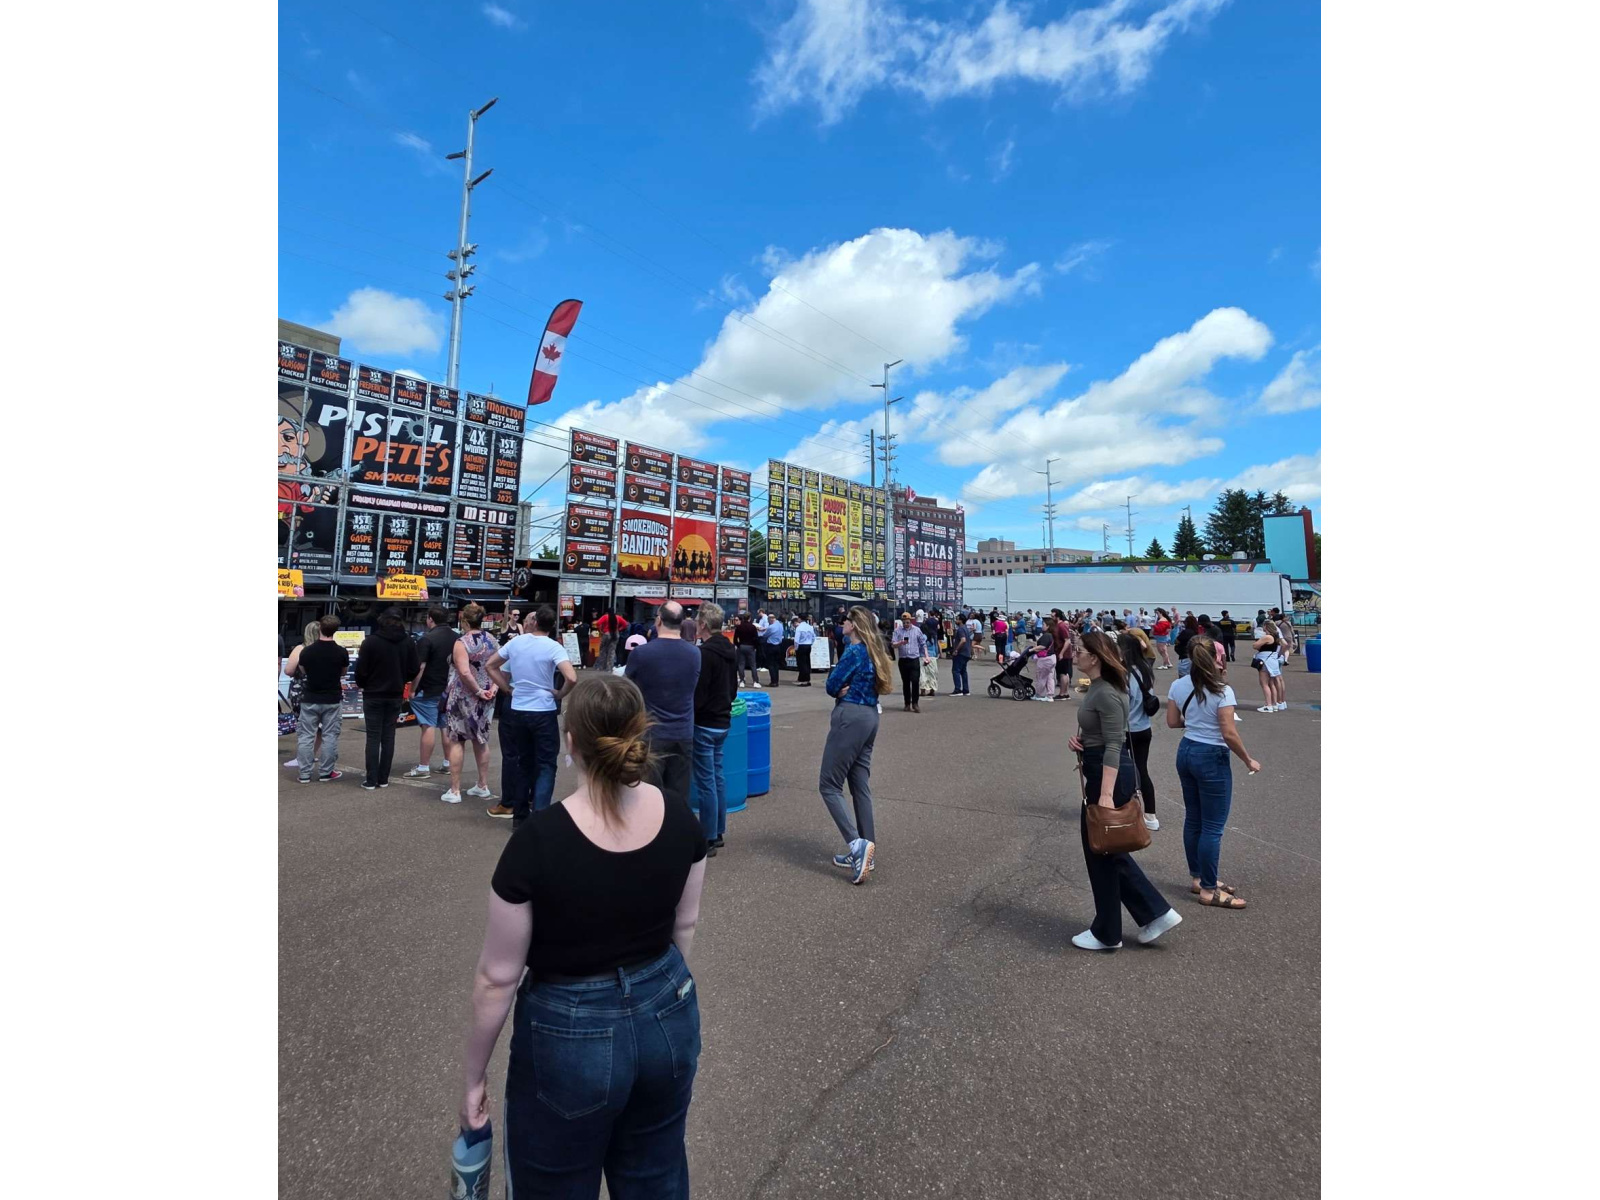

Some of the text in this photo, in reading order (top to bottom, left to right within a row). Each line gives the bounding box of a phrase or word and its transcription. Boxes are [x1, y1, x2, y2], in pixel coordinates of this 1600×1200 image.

[282, 345, 295, 354] 1ST
[281, 360, 306, 371] GLASGOW
[281, 368, 304, 378] CHICKEN
[321, 369, 340, 380] GASPE
[326, 380, 347, 389] CHICKEN
[359, 381, 390, 394] FREDERICTON
[398, 389, 422, 400] HALIFAX
[436, 398, 452, 408] GASPE
[473, 400, 485, 408] 1ST
[487, 400, 523, 419] MONCTON
[318, 404, 448, 444] PISTOL
[491, 413, 518, 425] BEST RIBS
[503, 423, 520, 431] SAUCE
[469, 430, 485, 446] 4X
[501, 439, 515, 448] 1ST
[353, 437, 451, 472] PETE'S
[465, 444, 488, 455] WINNER
[496, 459, 518, 469] SYDNEY
[496, 467, 516, 476] RIBFEST
[364, 471, 451, 485] SMOKEHOUSE
[352, 495, 376, 505] PROUDLY
[376, 498, 400, 508] CANADIAN
[423, 504, 445, 512] OPERATED
[497, 494, 512, 503] 2025
[354, 515, 371, 524] 1ST
[464, 506, 508, 524] MENU
[392, 519, 407, 527] 1ST
[623, 519, 668, 536] SMOKEHOUSE
[350, 534, 372, 543] GASPE
[424, 541, 442, 549] GASPE
[621, 533, 668, 557] BANDITS
[916, 540, 953, 560] TEXAS
[769, 576, 785, 588] BEST
[786, 578, 800, 588] RIBS
[851, 580, 862, 590] BEST
[864, 581, 873, 590] RIBS
[926, 576, 942, 589] BBQ
